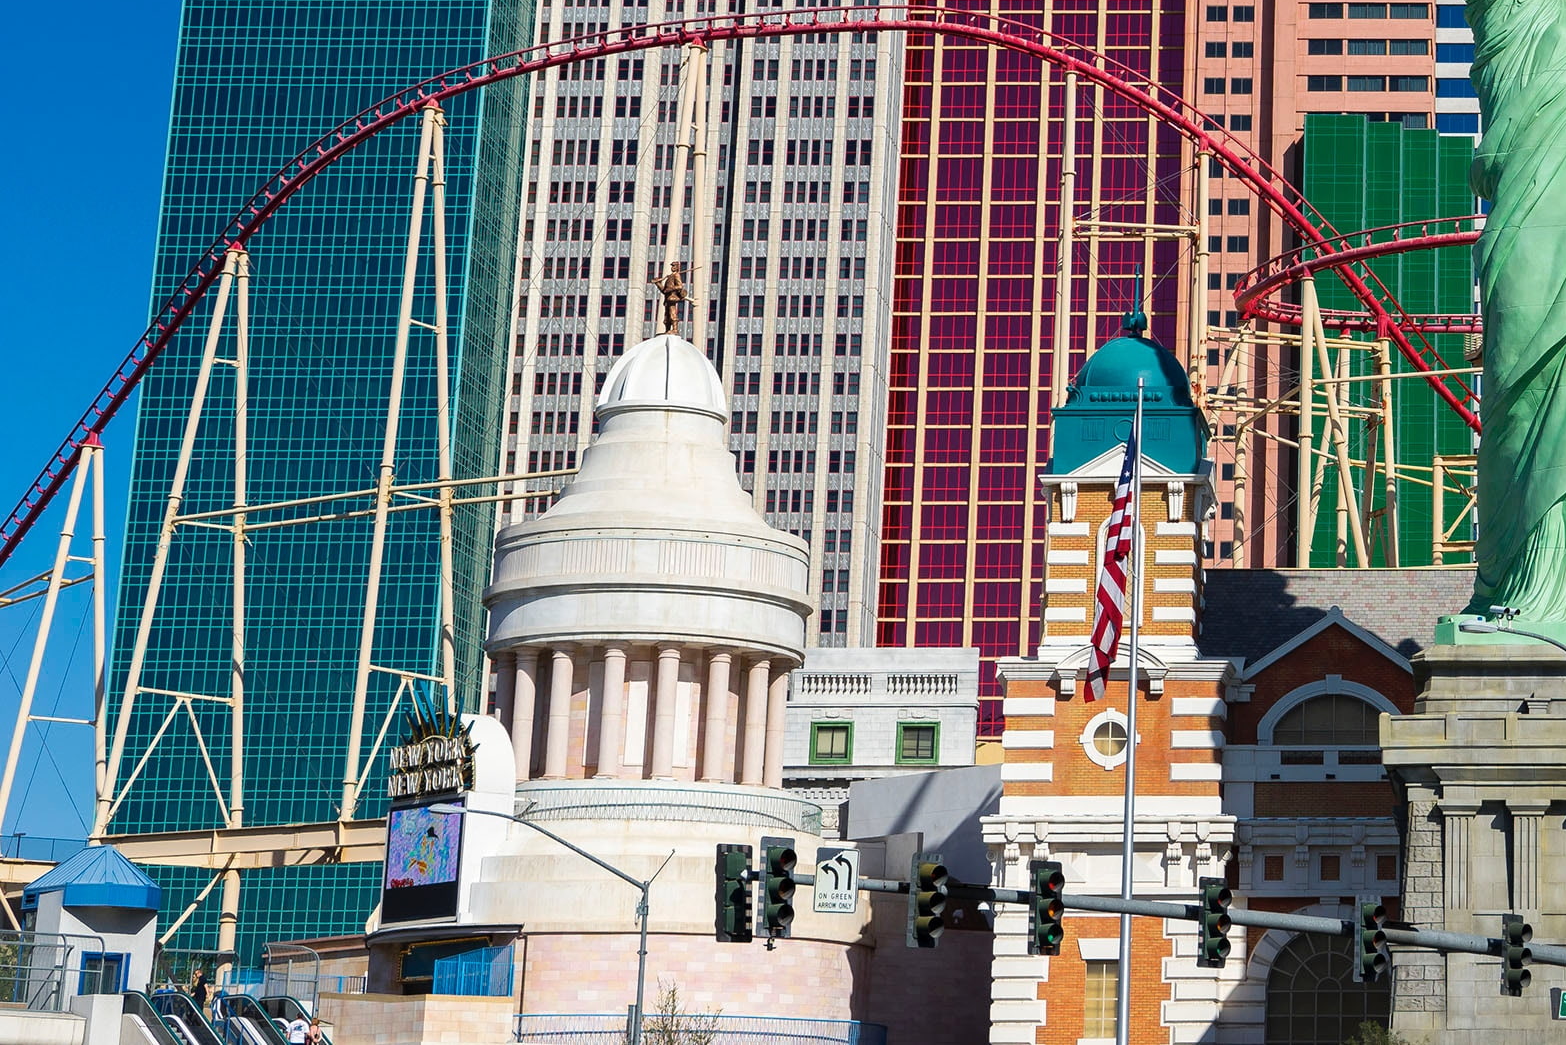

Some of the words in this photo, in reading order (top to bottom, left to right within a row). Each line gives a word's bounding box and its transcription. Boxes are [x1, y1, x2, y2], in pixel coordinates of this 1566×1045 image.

[390, 743, 426, 770] NEW
[426, 738, 466, 764] YORK
[387, 772, 422, 797] NEW
[424, 766, 464, 792] YORK
